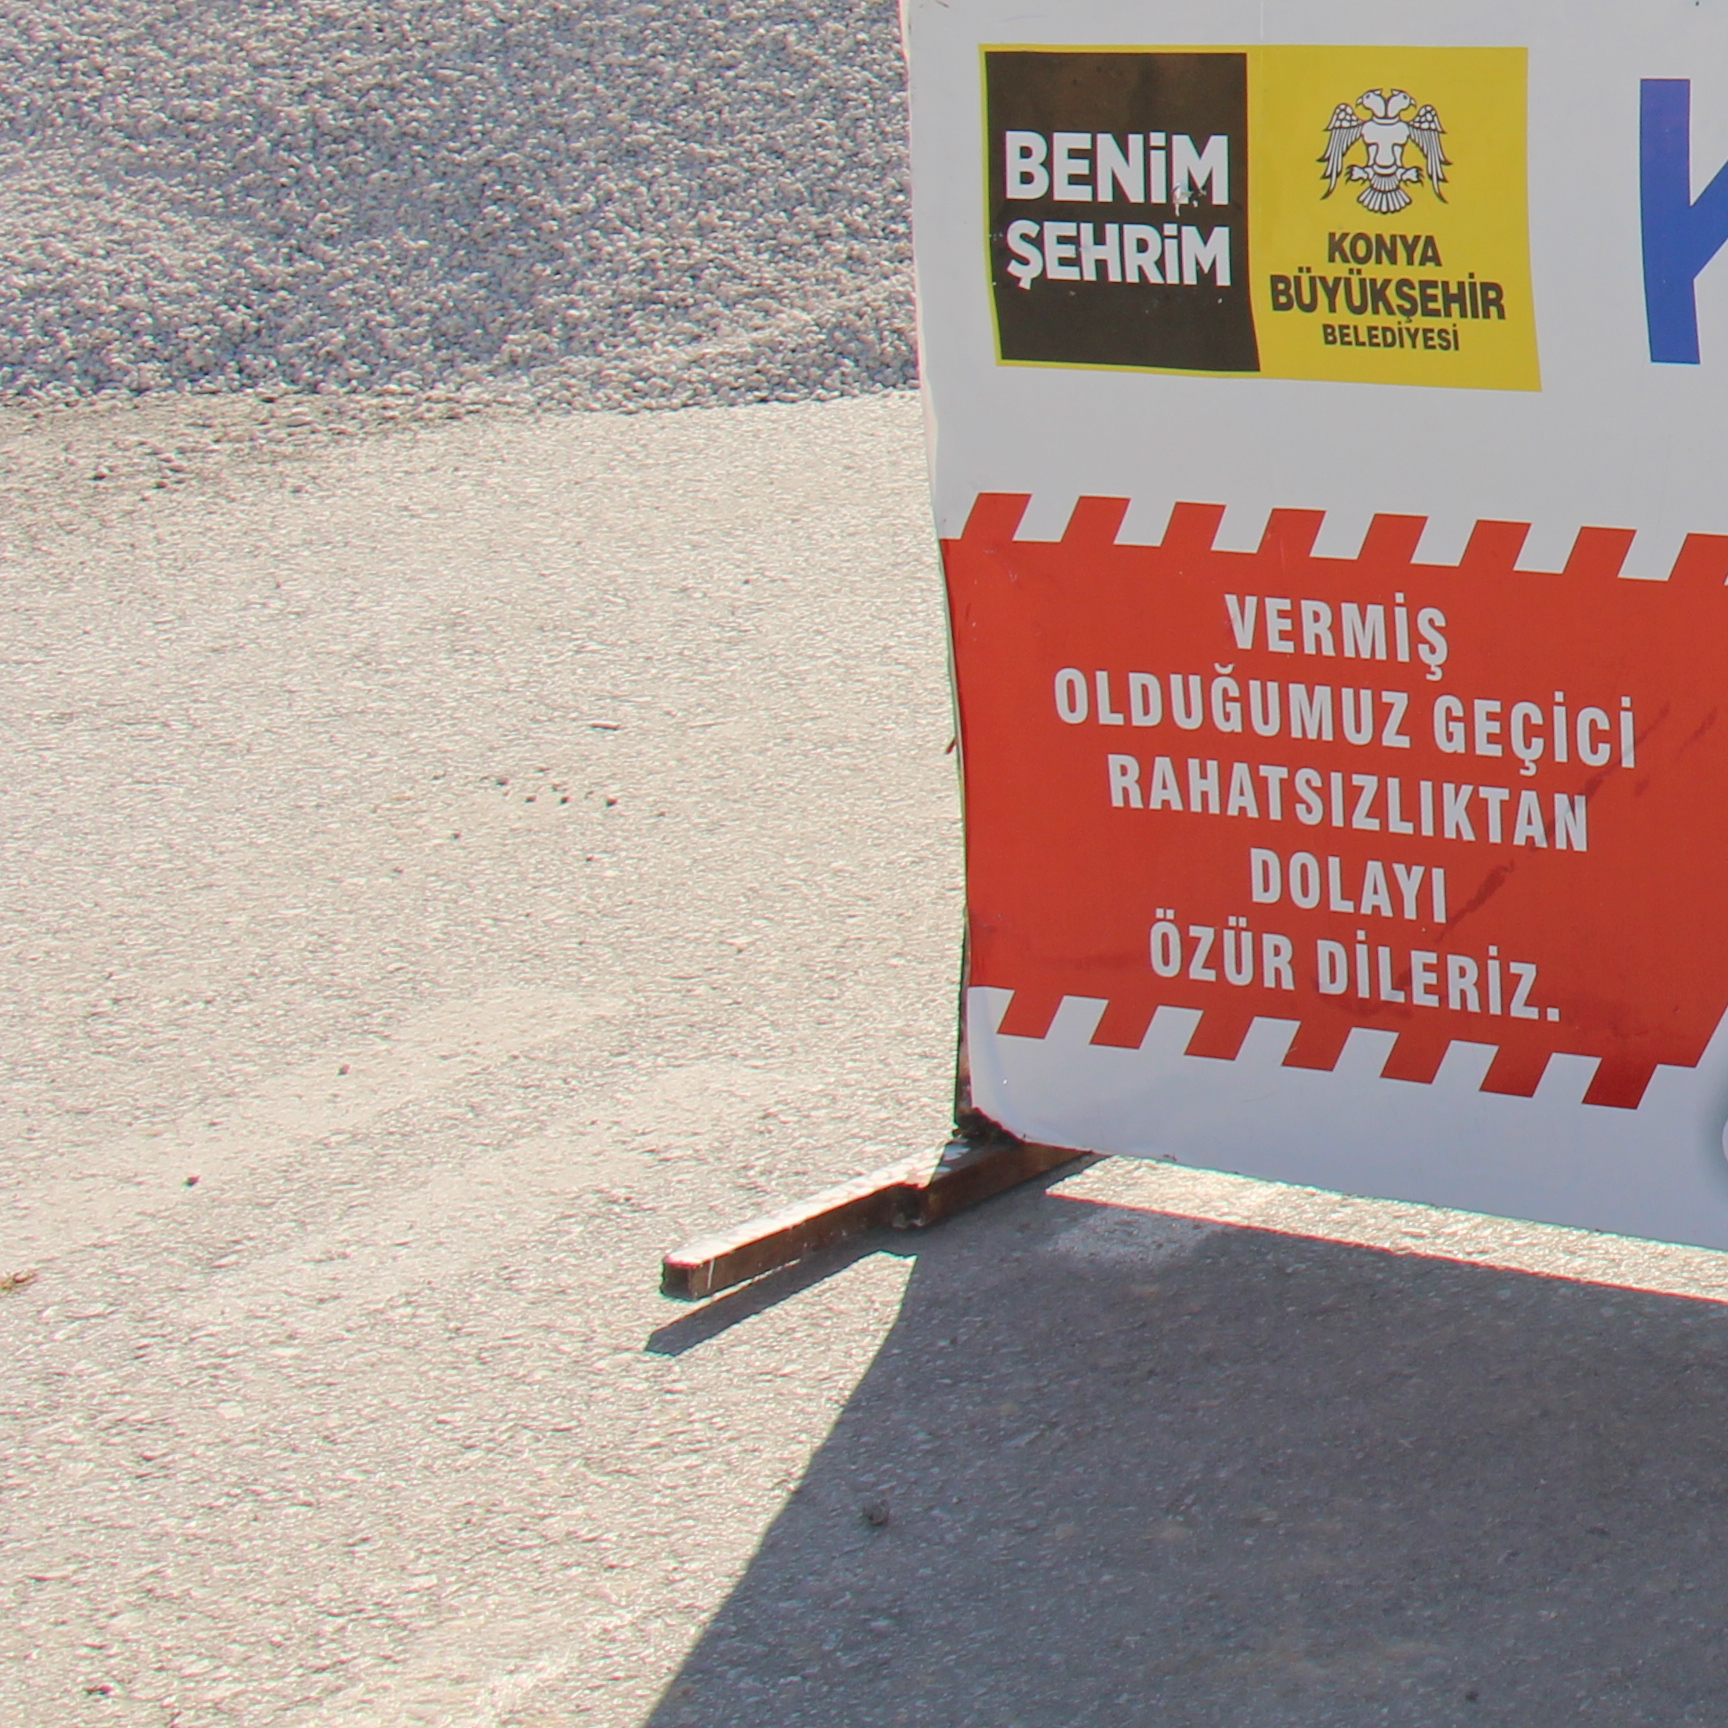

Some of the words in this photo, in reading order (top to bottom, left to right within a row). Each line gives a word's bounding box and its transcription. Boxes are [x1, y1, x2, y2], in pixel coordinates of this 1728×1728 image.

[1005, 130, 1229, 205] BENİM
[1006, 219, 1231, 290] ŞEHRİM
[1328, 232, 1442, 267] KONYA
[1270, 266, 1506, 323] BÜYÜKŞEHİR
[1322, 321, 1460, 352] BELEDİYESİ
[1225, 592, 1449, 681] VERMİŞ
[1054, 663, 1411, 750] OLDUĞUMUZ
[1433, 690, 1636, 777] GEÇİCİ
[1107, 753, 1588, 853] RAHATSIZLIKTAN
[1250, 847, 1448, 924] DOLAYI
[1150, 909, 1294, 991] ÖZÜR
[1317, 929, 1560, 1023] DİLERİZ.
